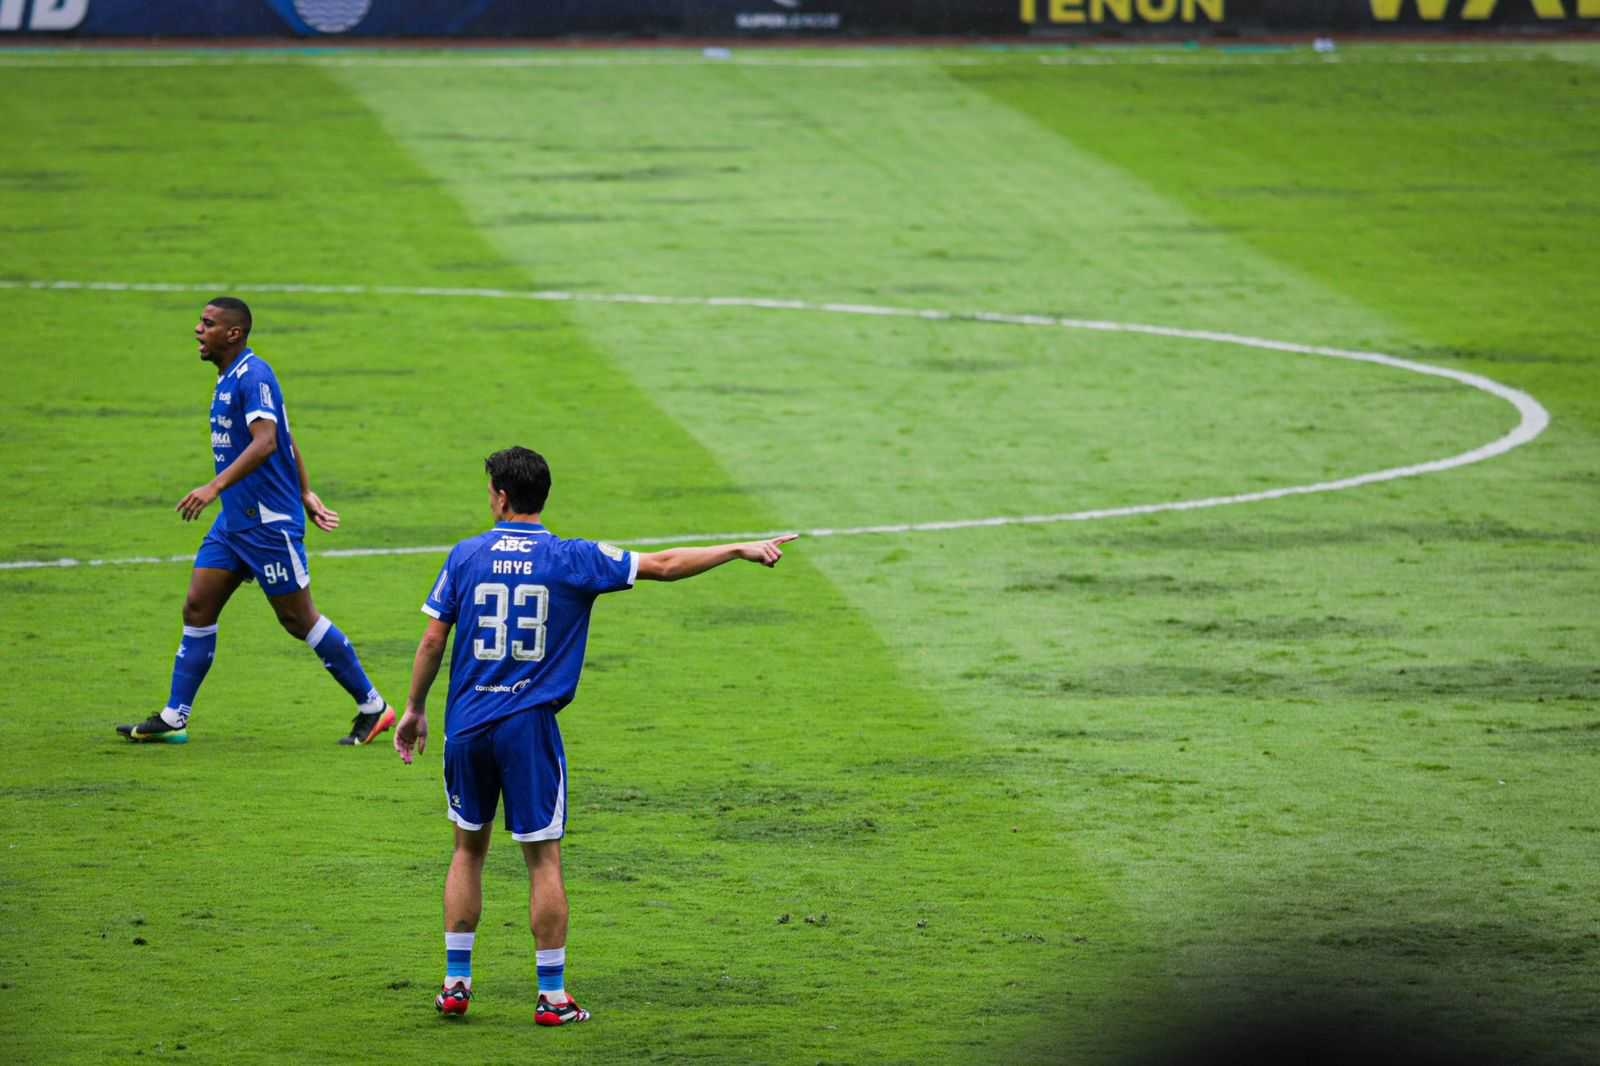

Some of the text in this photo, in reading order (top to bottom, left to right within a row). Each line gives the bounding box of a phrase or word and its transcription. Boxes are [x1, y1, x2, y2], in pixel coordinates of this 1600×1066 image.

[490, 539, 534, 553] ABC
[263, 561, 289, 584] 94
[492, 559, 533, 575] HAYE
[473, 582, 550, 662] 33
